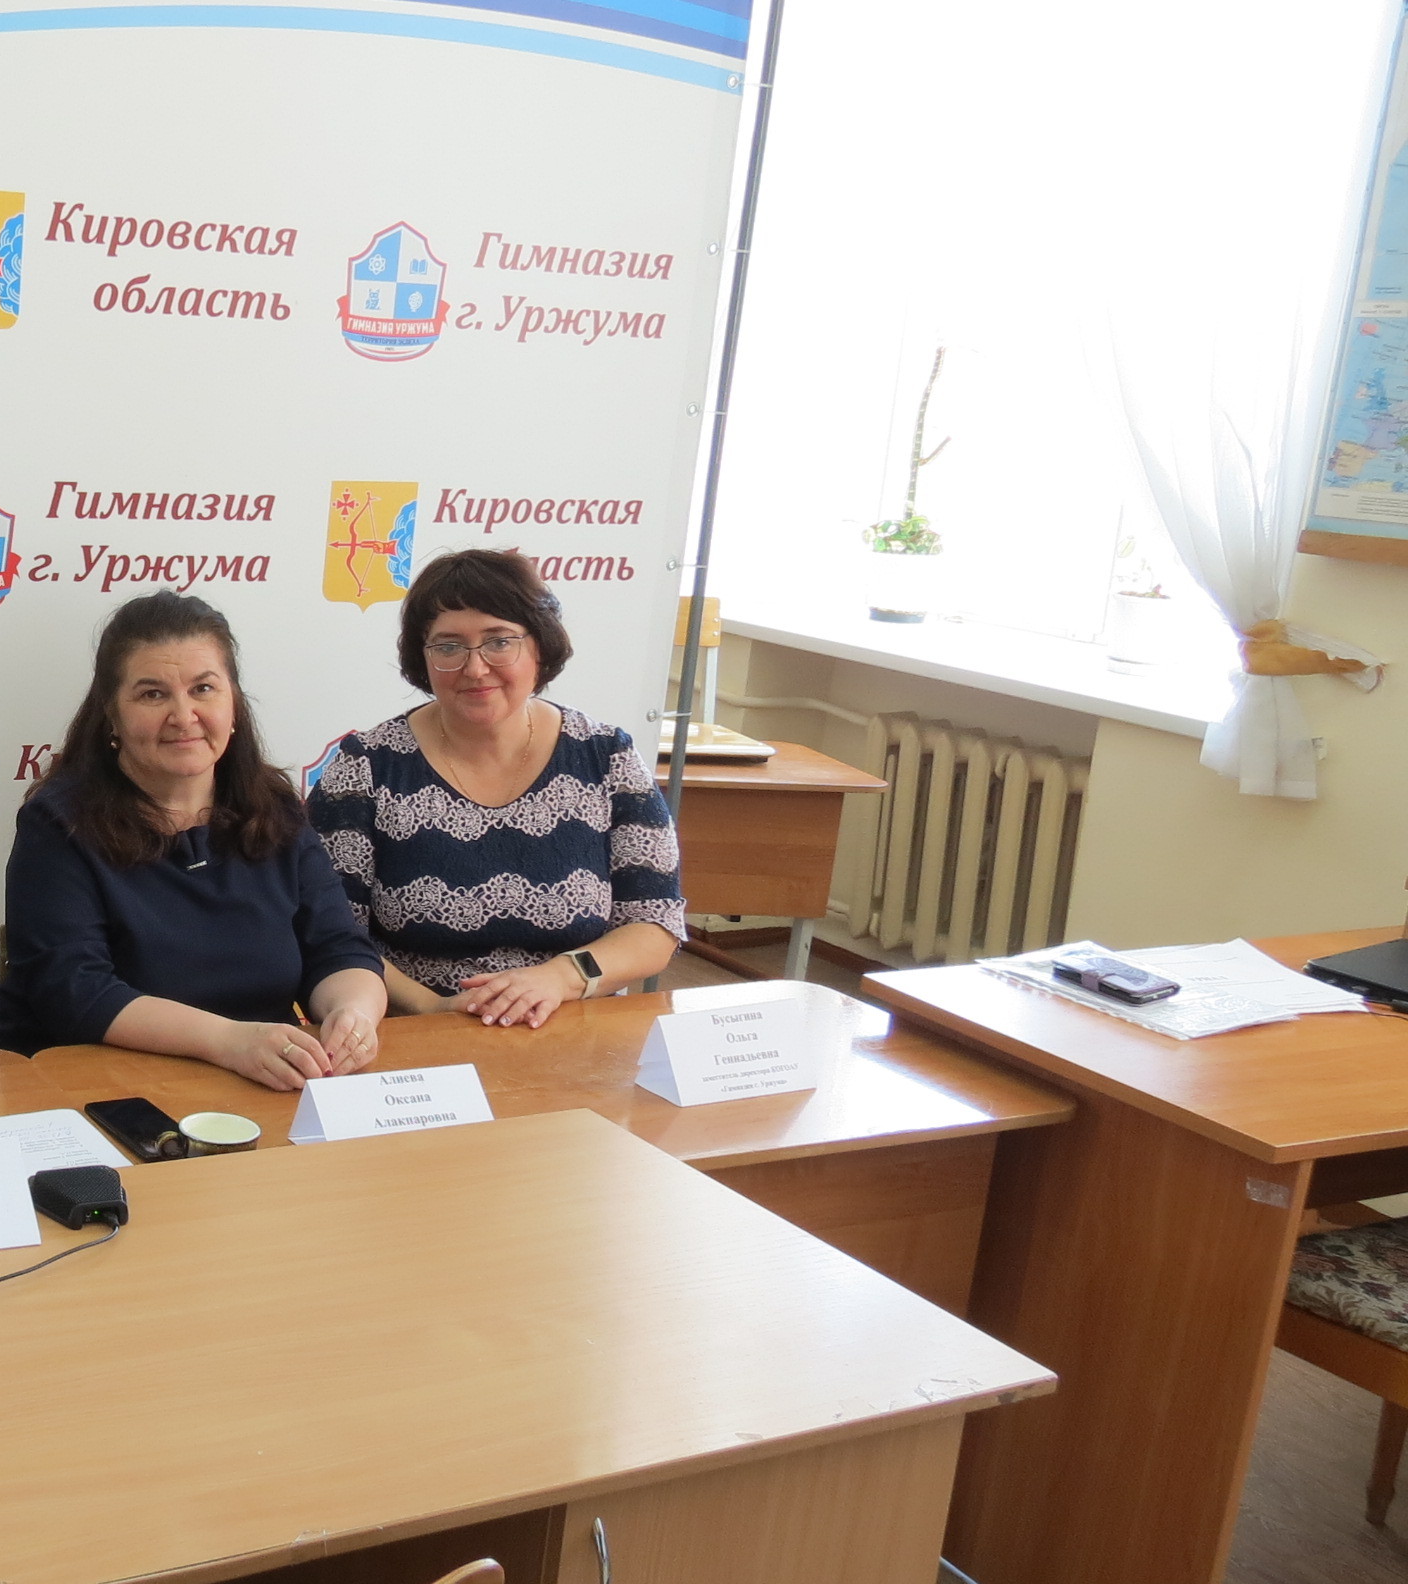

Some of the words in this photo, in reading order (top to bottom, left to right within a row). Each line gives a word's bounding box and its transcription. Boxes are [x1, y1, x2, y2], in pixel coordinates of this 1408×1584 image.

[44, 201, 298, 257] Кировская
[474, 231, 674, 281] Гимназия
[92, 274, 292, 321] область
[346, 317, 393, 334] ГИМНАЗИЯ
[395, 322, 435, 334] УРЖУМА
[455, 301, 484, 330] г.
[494, 295, 667, 346] Уржума
[46, 481, 276, 522] Гимназия
[432, 488, 644, 534] Кировская
[27, 554, 60, 583] г.
[72, 544, 271, 593] Уржума
[711, 1010, 763, 1027] Бусыгина
[726, 1031, 759, 1044] Ольга
[378, 1072, 426, 1086] Алиева
[384, 1091, 432, 1106] Оксана
